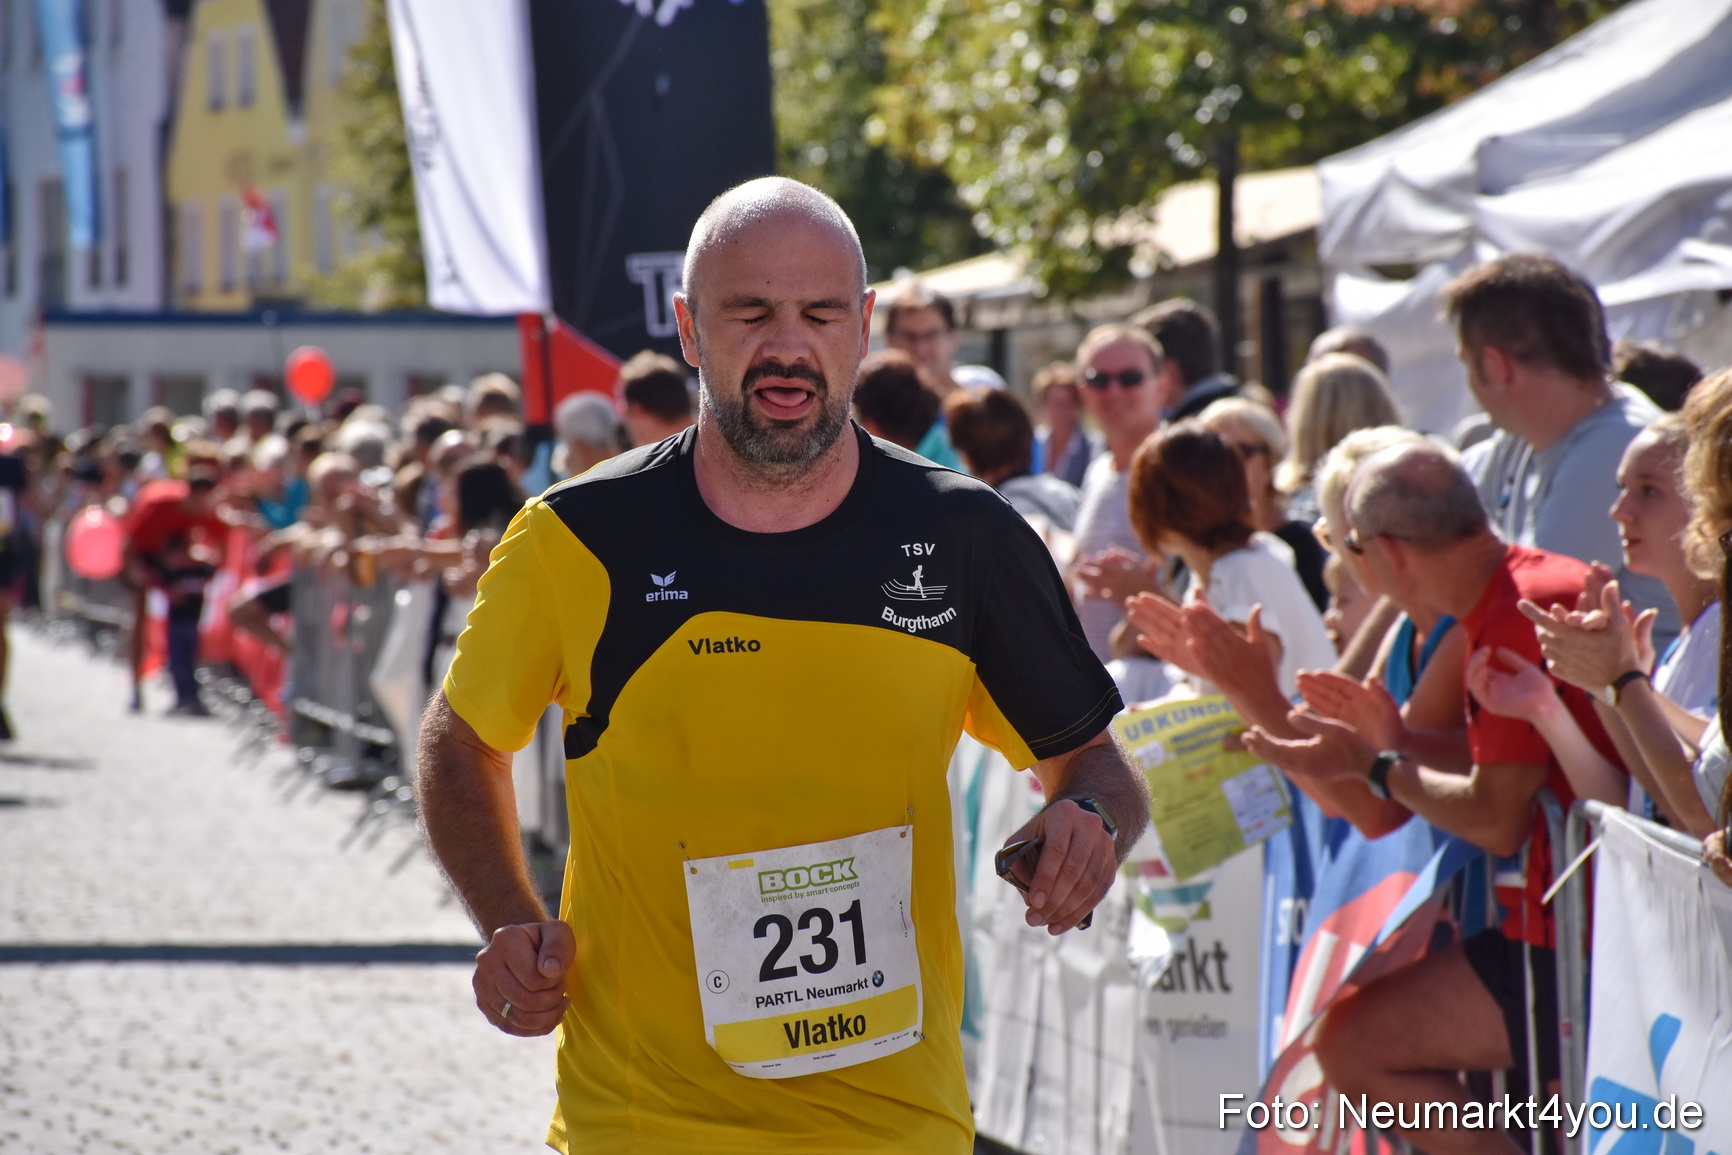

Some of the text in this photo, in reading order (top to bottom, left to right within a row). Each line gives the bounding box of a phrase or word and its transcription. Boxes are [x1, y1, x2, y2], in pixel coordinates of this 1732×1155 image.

[901, 542, 936, 557] TSV
[645, 588, 689, 603] erima
[881, 605, 957, 633] Burgthann
[687, 636, 761, 656] Vlatko
[758, 856, 859, 895] BOCK
[761, 880, 860, 904] inspired by smart concepts
[753, 899, 867, 983] 231
[713, 975, 722, 989] C
[755, 978, 869, 1009] PARTL Neumarkt
[783, 1013, 867, 1050] Vlatko
